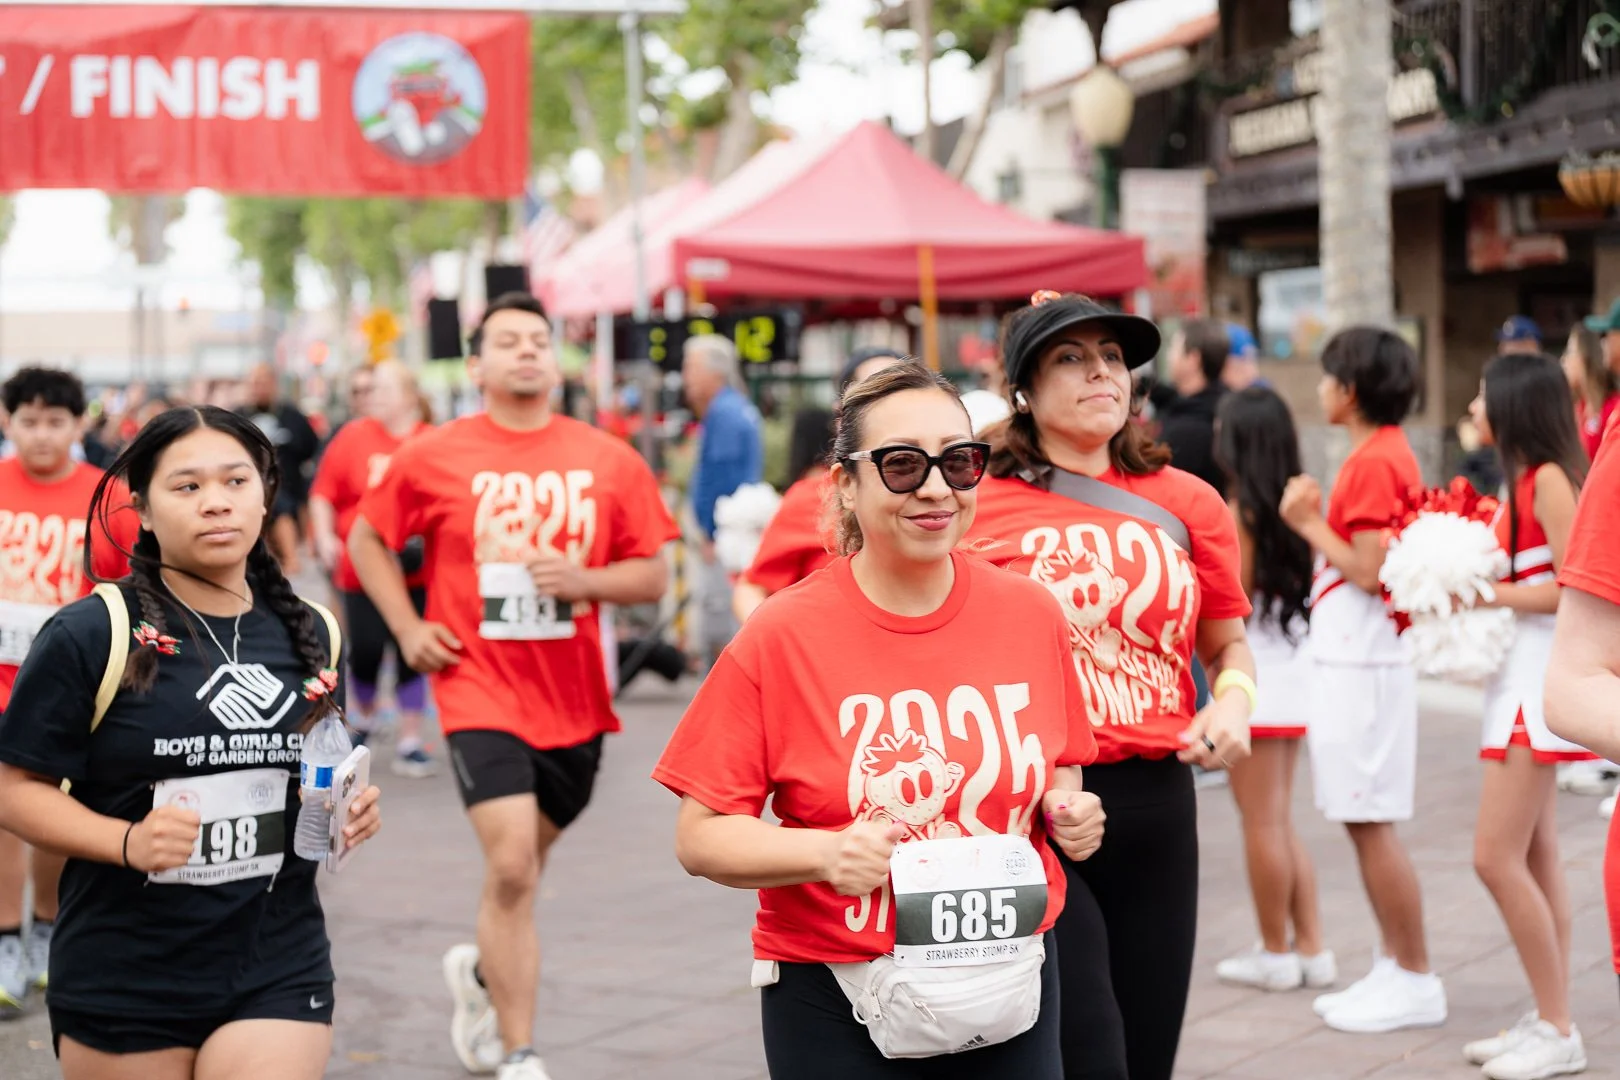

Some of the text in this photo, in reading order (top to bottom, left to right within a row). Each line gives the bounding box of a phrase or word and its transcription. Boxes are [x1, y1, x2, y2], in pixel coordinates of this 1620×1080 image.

[70, 54, 319, 120] FINISH
[472, 470, 597, 567] 2025
[153, 737, 206, 756] BOYS
[210, 735, 225, 750] &
[229, 733, 282, 750] GIRLS
[186, 753, 206, 766] OF
[209, 750, 265, 765] GARDEN
[838, 683, 1046, 837] 2025
[931, 888, 1018, 943] 685
[926, 944, 1020, 961] STRAWBERRY STOMP 5K
